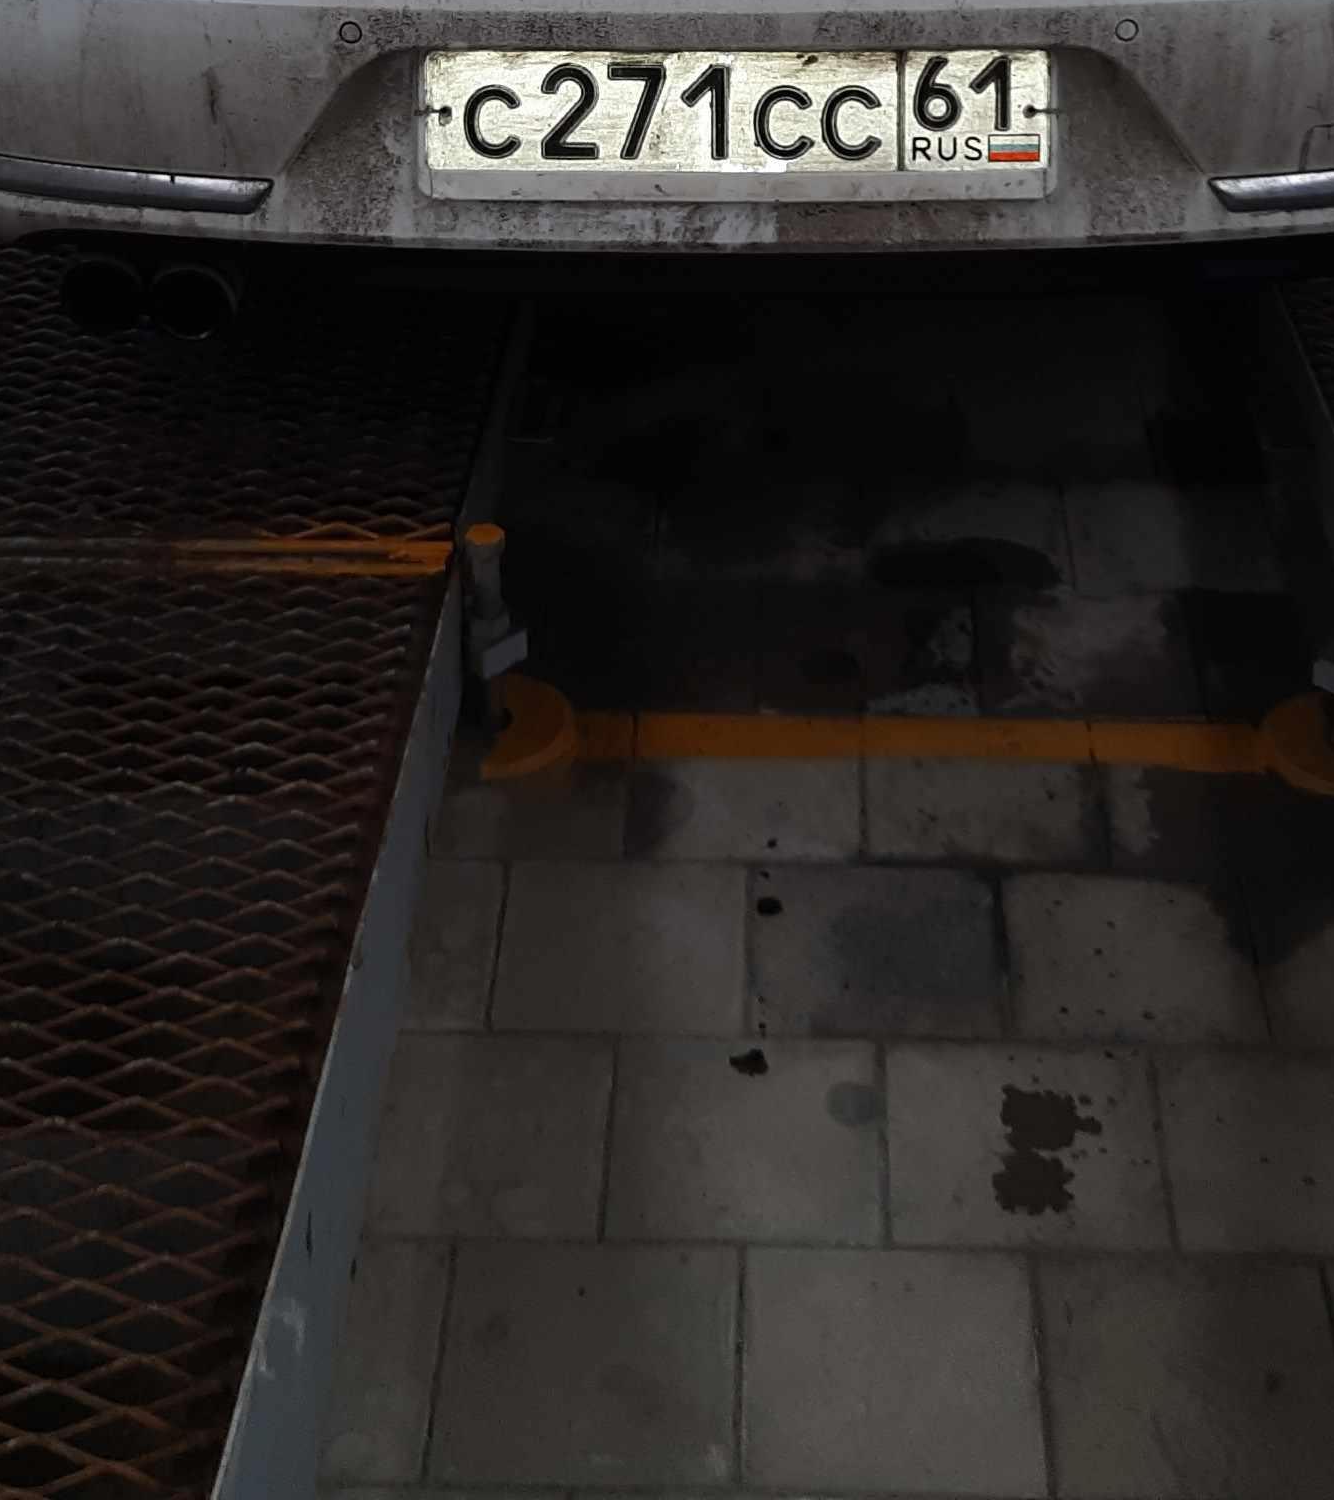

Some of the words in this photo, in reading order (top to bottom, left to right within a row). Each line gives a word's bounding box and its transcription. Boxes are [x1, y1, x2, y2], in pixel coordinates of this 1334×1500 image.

[462, 61, 883, 161] С271СС
[912, 55, 1013, 131] 61
[911, 135, 983, 162] RUS
